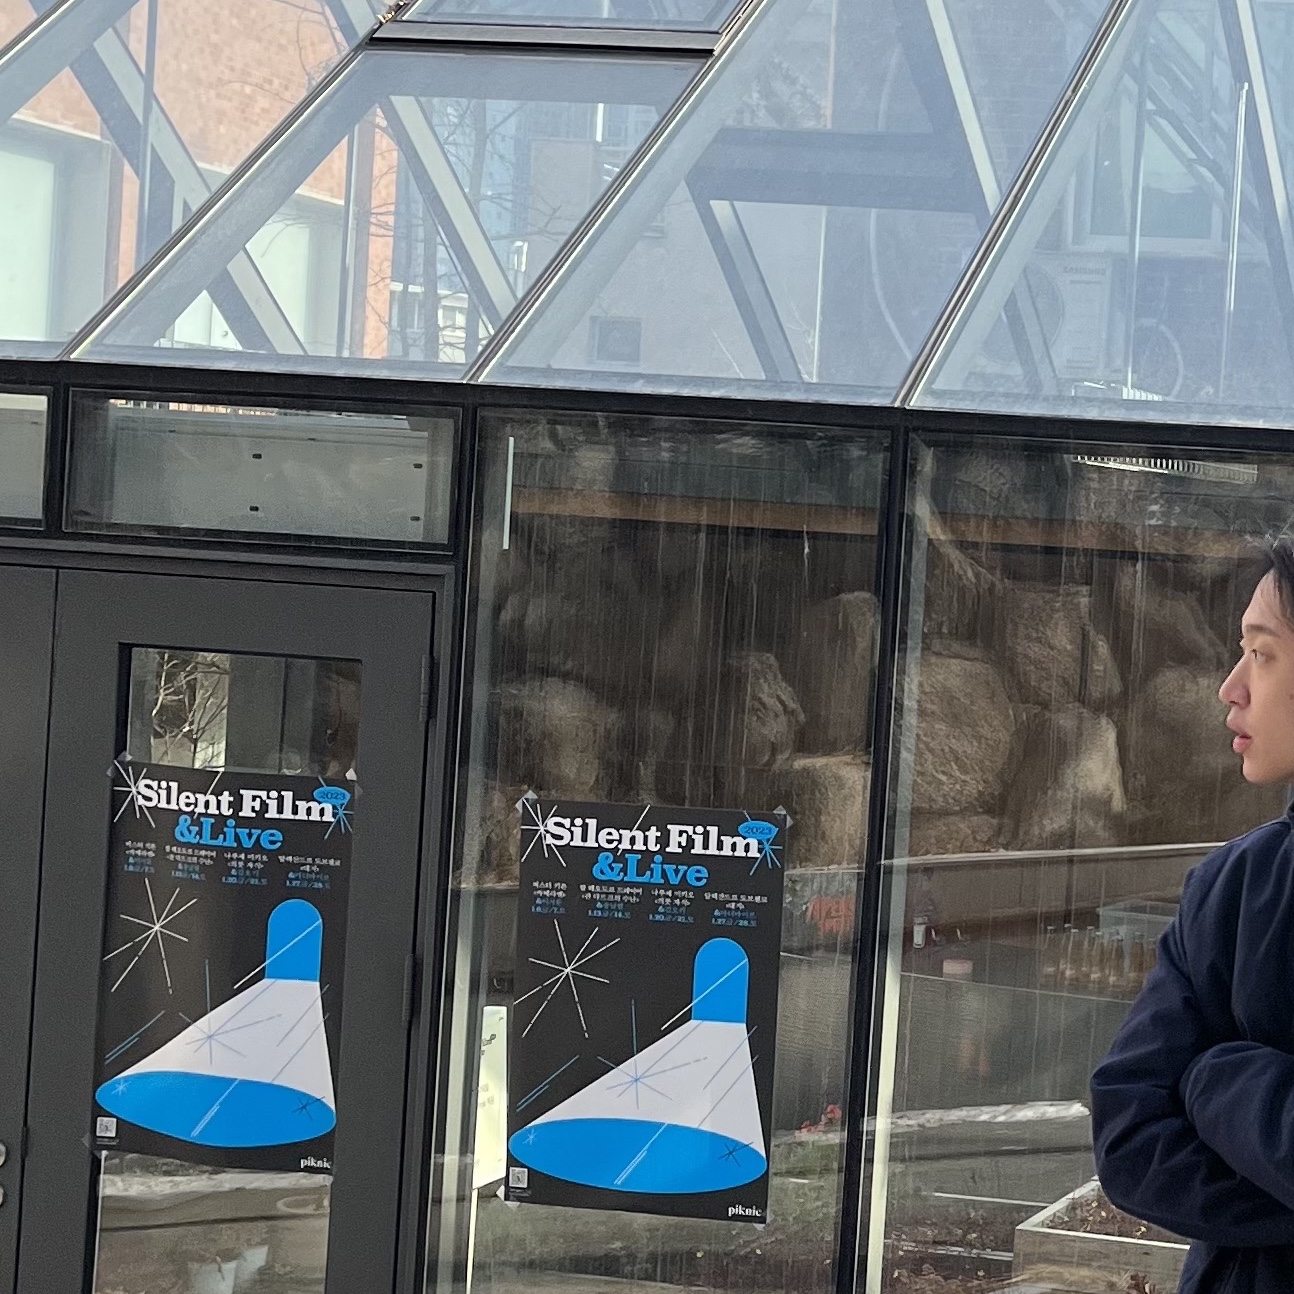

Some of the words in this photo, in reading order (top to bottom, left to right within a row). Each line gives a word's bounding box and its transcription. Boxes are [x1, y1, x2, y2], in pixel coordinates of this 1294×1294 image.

[138, 779, 234, 816] Silent
[239, 789, 334, 822] Film
[320, 791, 346, 800] 2023
[174, 814, 283, 849] &Live
[546, 816, 660, 852] Silent
[666, 824, 760, 857] Film
[744, 826, 772, 836] 2023
[592, 852, 708, 886] &Live
[728, 1204, 762, 1216] piknic
